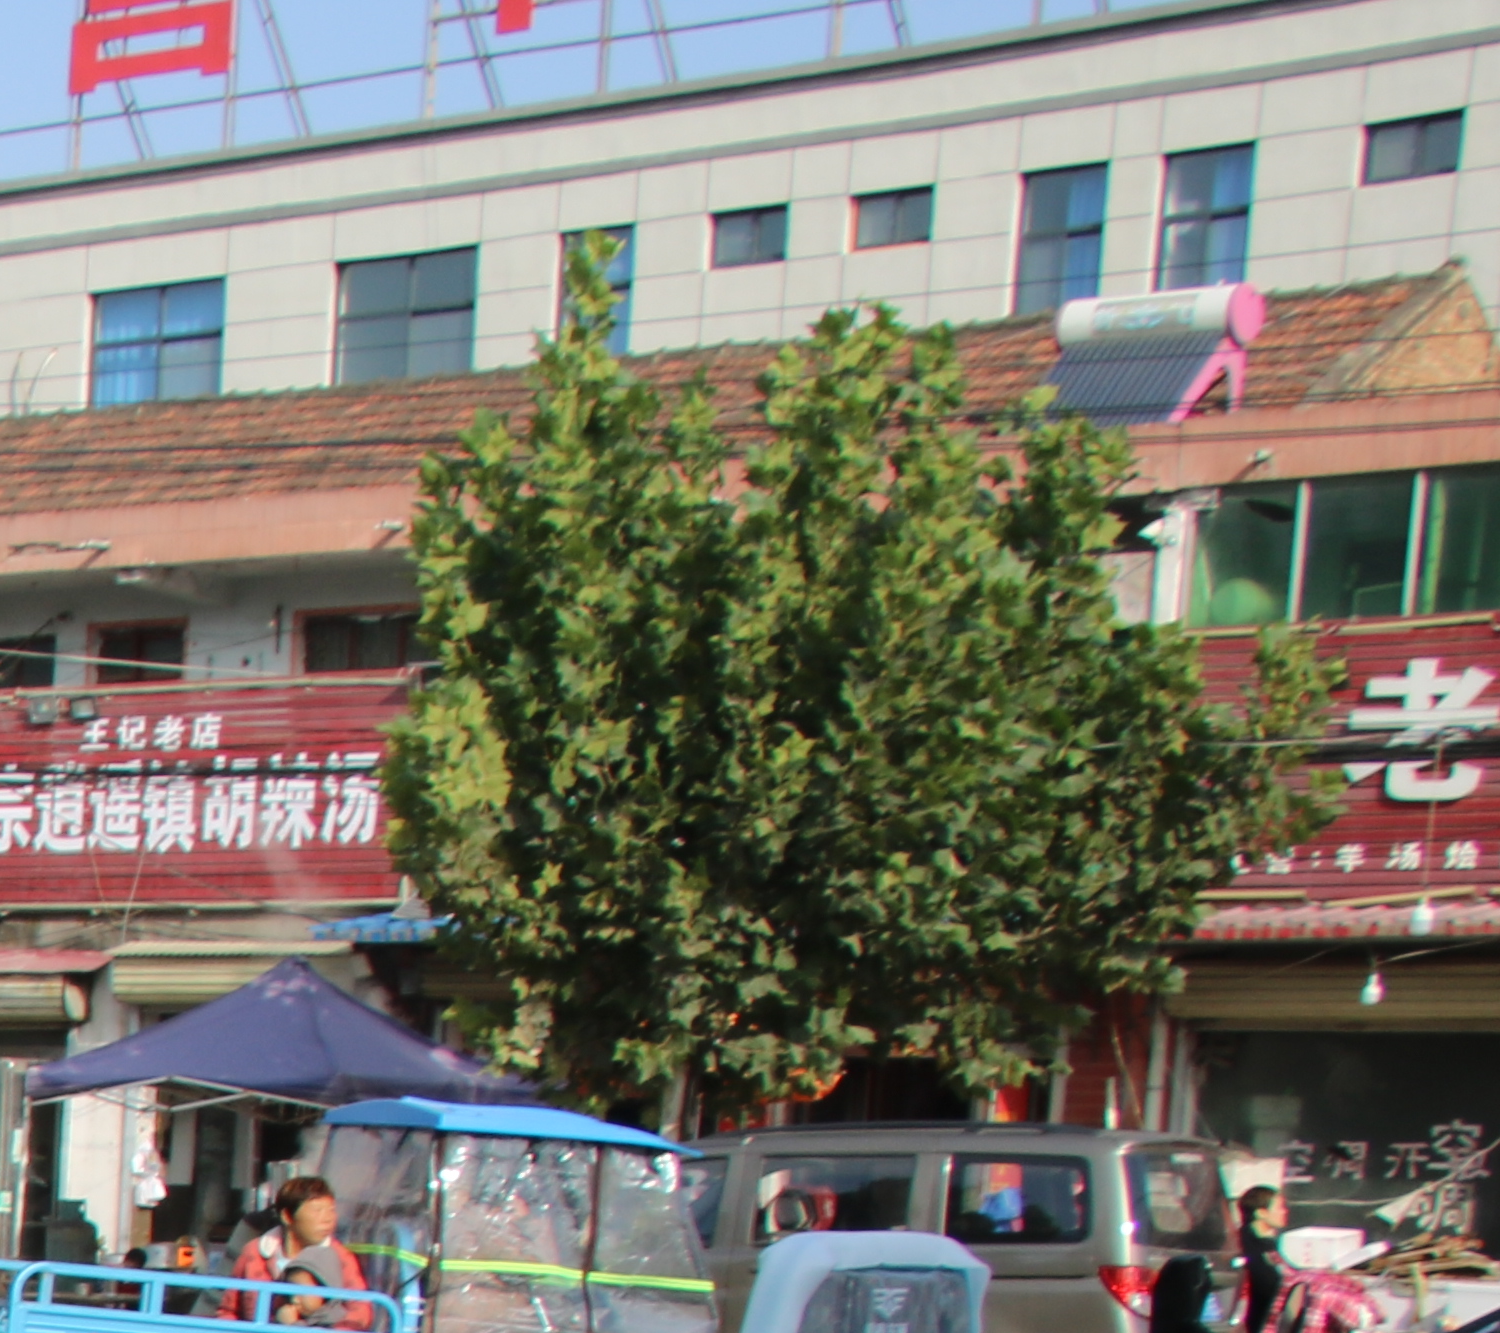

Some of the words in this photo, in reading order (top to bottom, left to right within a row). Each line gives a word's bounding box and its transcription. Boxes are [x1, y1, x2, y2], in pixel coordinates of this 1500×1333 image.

[79, 712, 224, 753] 王记老店
[1338, 657, 1500, 802] 老
